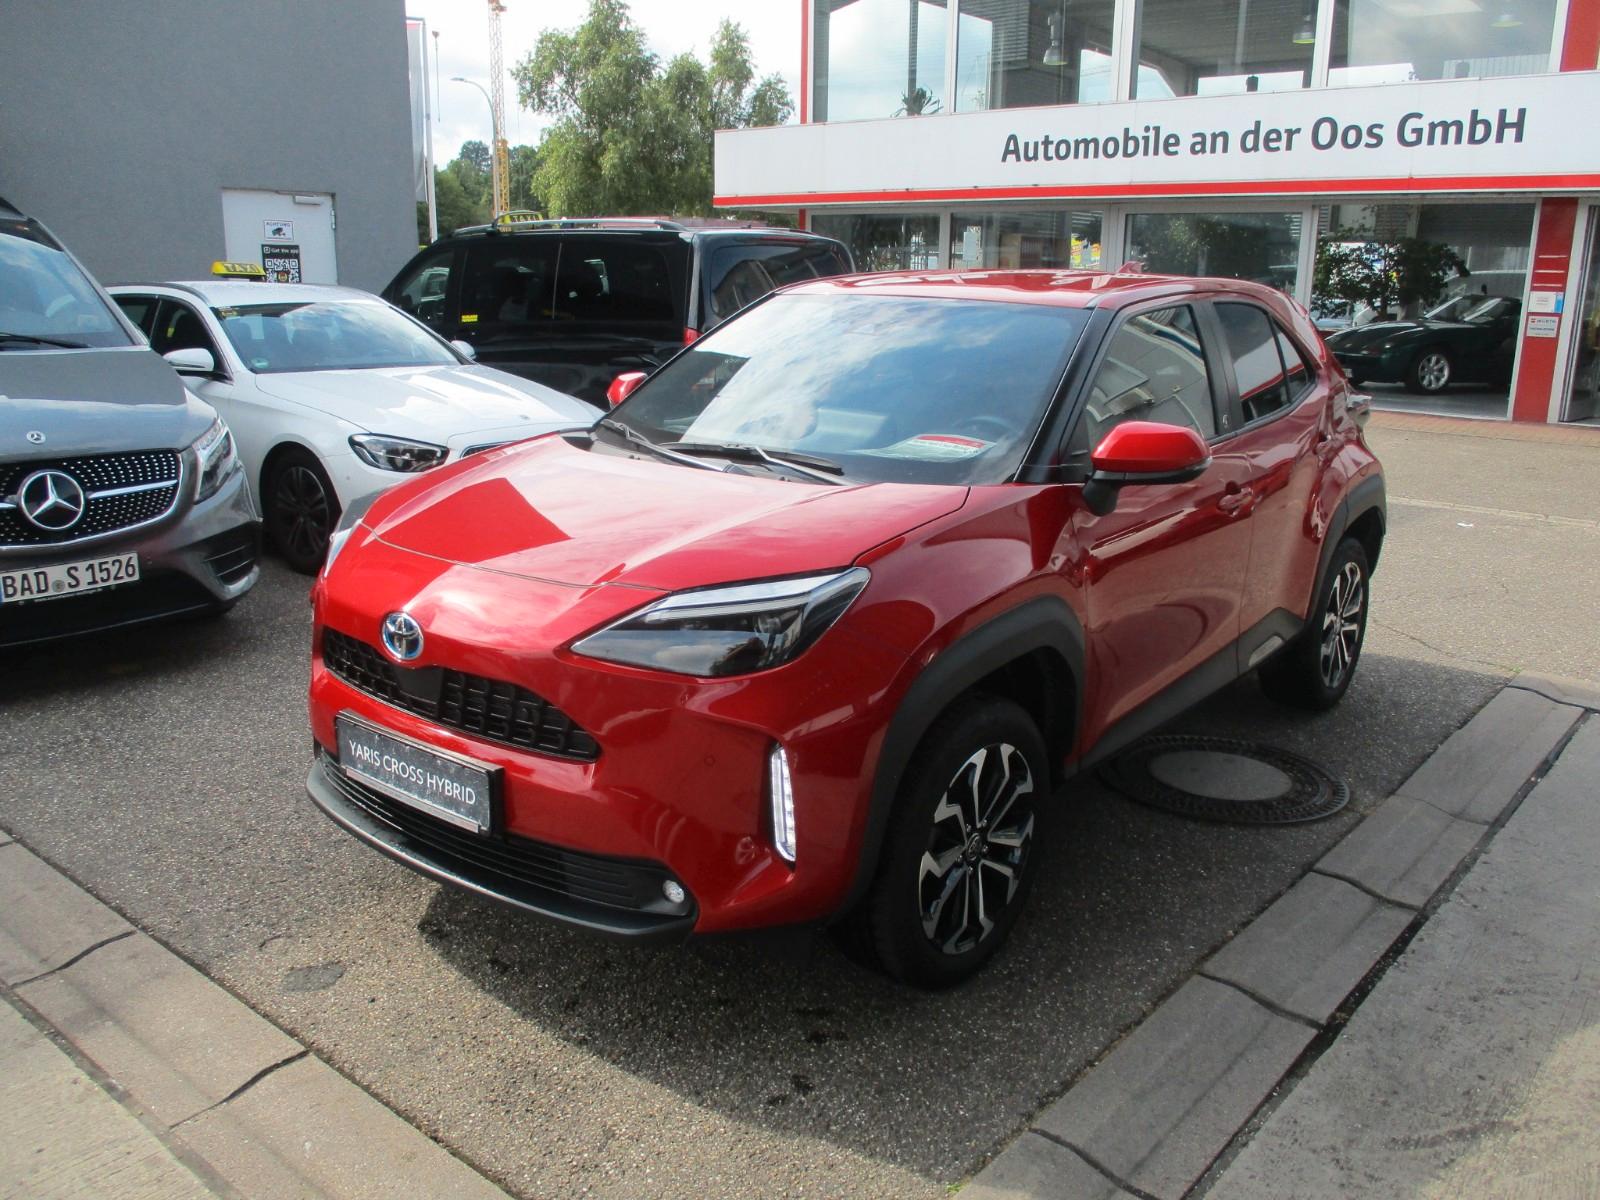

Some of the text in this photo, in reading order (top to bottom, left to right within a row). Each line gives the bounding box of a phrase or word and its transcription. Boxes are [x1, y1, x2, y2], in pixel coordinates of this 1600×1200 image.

[1001, 107, 1527, 163] Automobile an der Oos GmbH
[223, 264, 261, 273] TAXI
[1, 571, 50, 599] BAD
[66, 566, 81, 588] S
[85, 556, 137, 587] 1526
[349, 740, 477, 805] YARIS CROSS HYBRID
